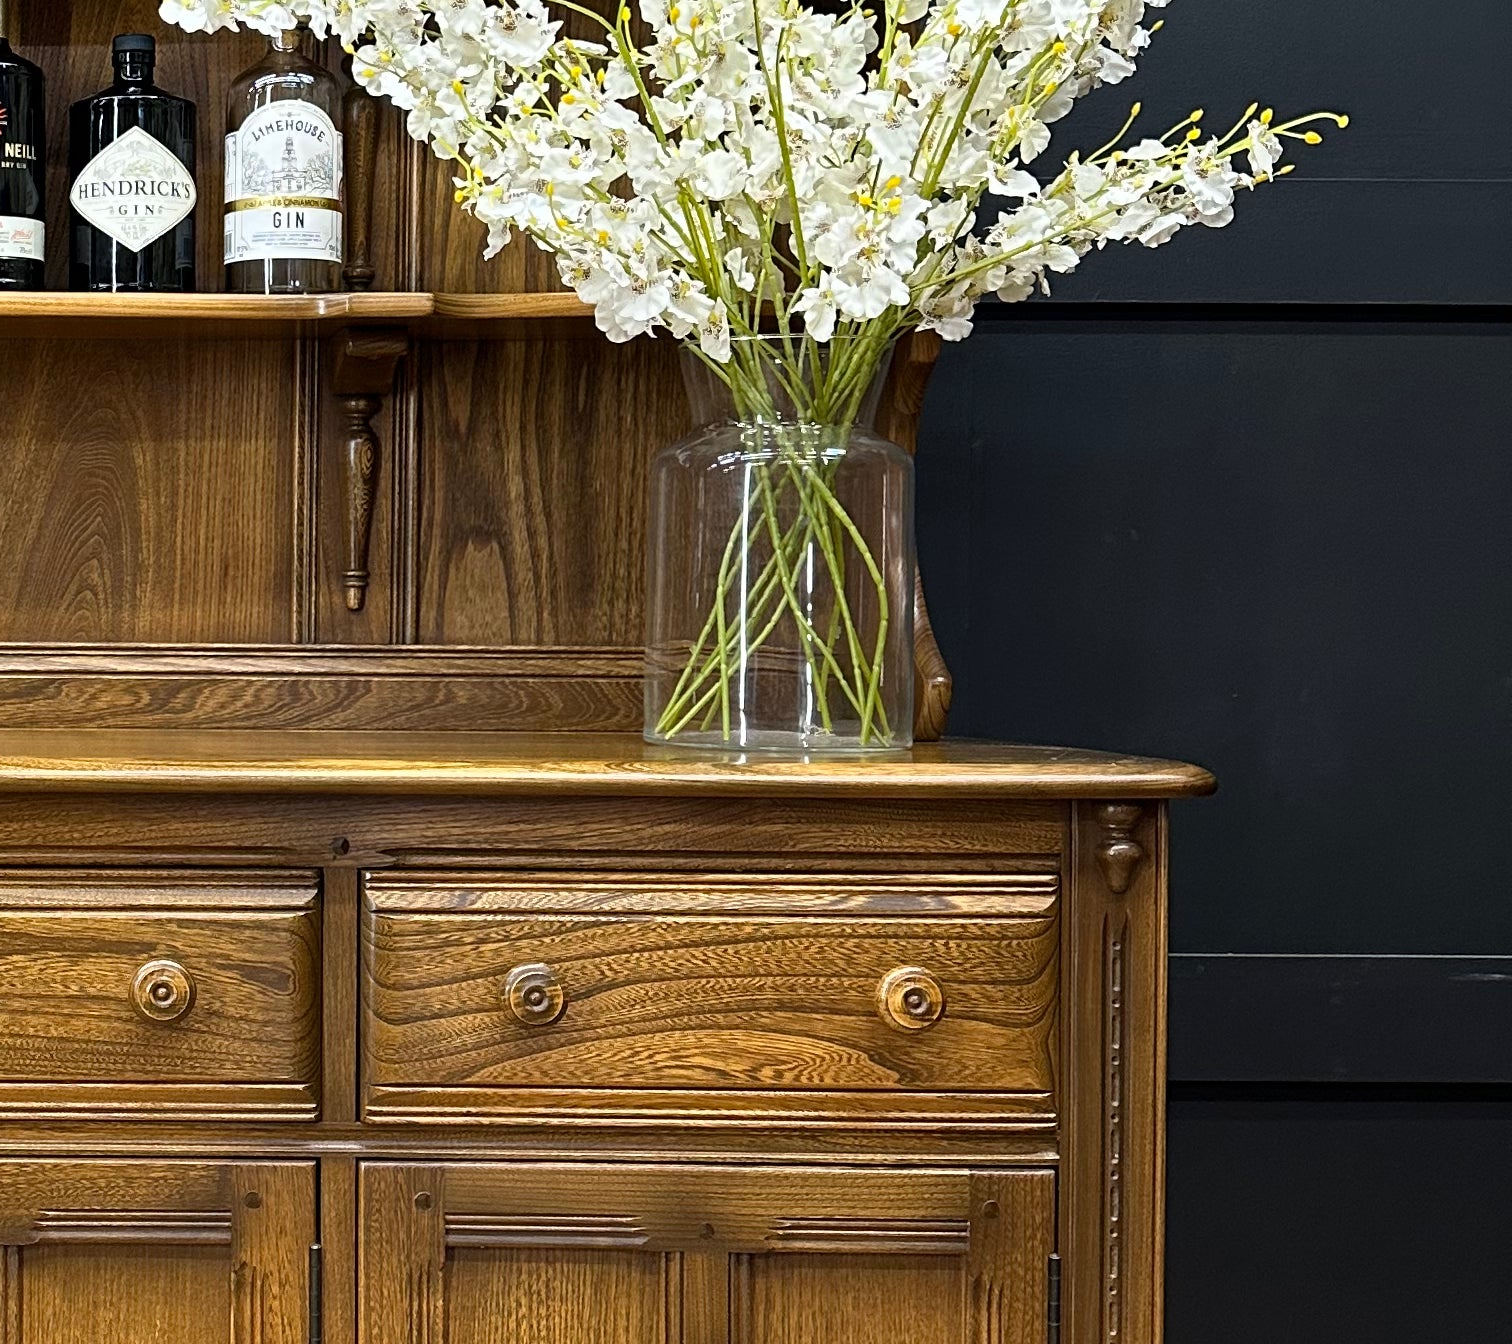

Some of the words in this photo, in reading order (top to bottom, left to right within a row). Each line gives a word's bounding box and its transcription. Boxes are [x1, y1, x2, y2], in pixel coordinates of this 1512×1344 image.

[252, 119, 327, 144] LIMEHOUSE
[4, 142, 37, 161] NEILL
[78, 179, 191, 200] HENDRICK'S
[118, 204, 155, 216] GIN
[273, 212, 305, 229] GIN
